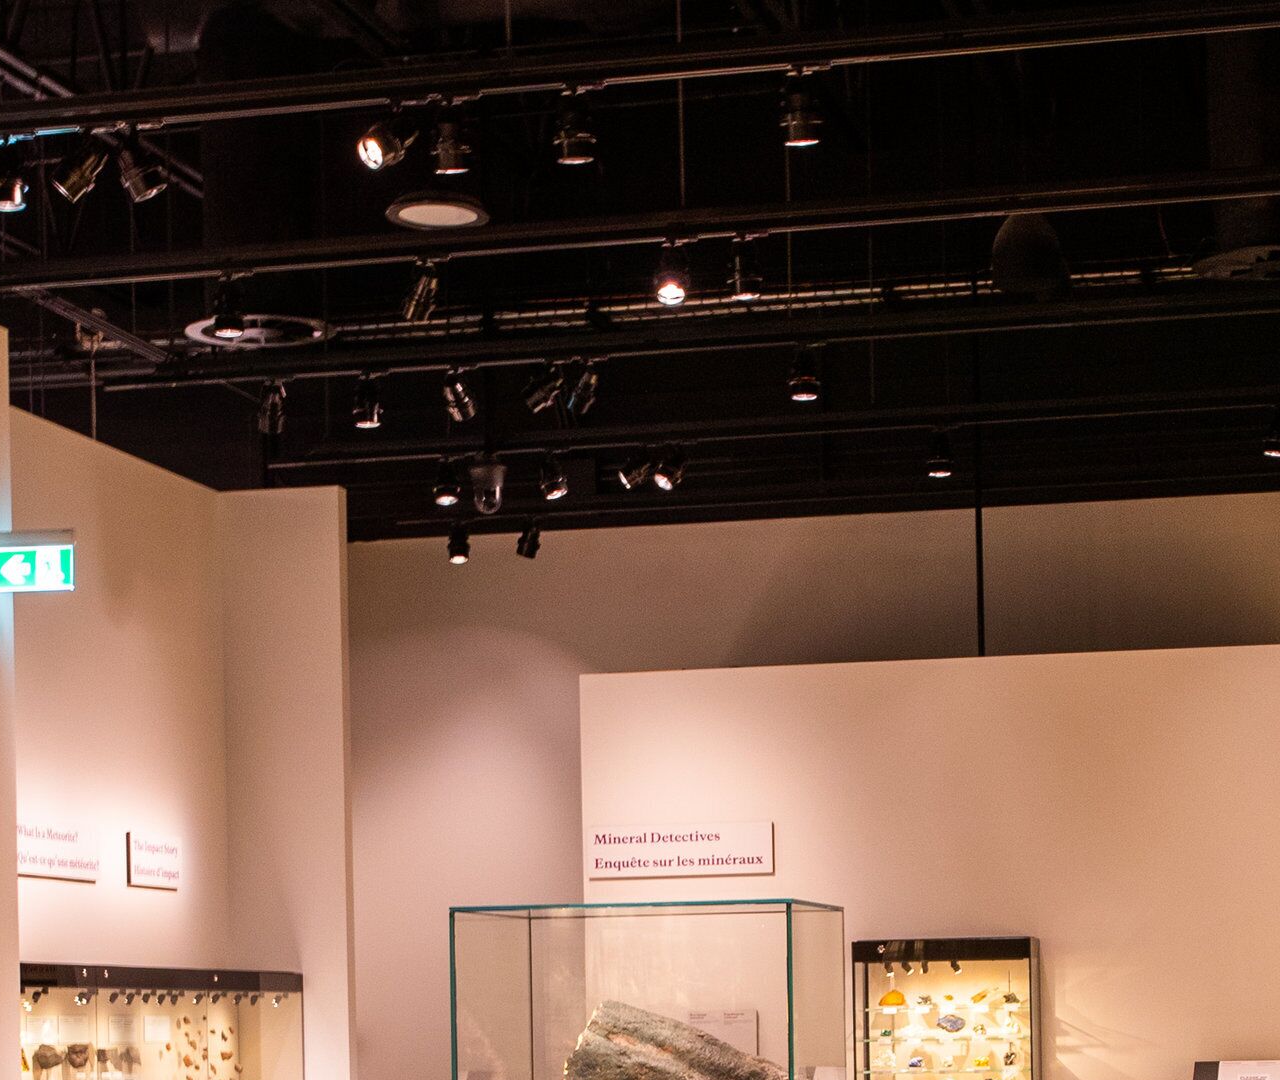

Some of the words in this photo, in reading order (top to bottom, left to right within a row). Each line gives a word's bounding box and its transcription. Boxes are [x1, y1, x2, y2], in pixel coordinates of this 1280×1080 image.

[17, 824, 34, 839] What
[47, 828, 78, 843] Meteorite?
[593, 833, 647, 846] Mineral
[650, 830, 721, 844] Detectives
[594, 857, 650, 871] Enquête
[652, 858, 675, 868] sur
[677, 855, 695, 867] les
[698, 853, 764, 866] minéraux
